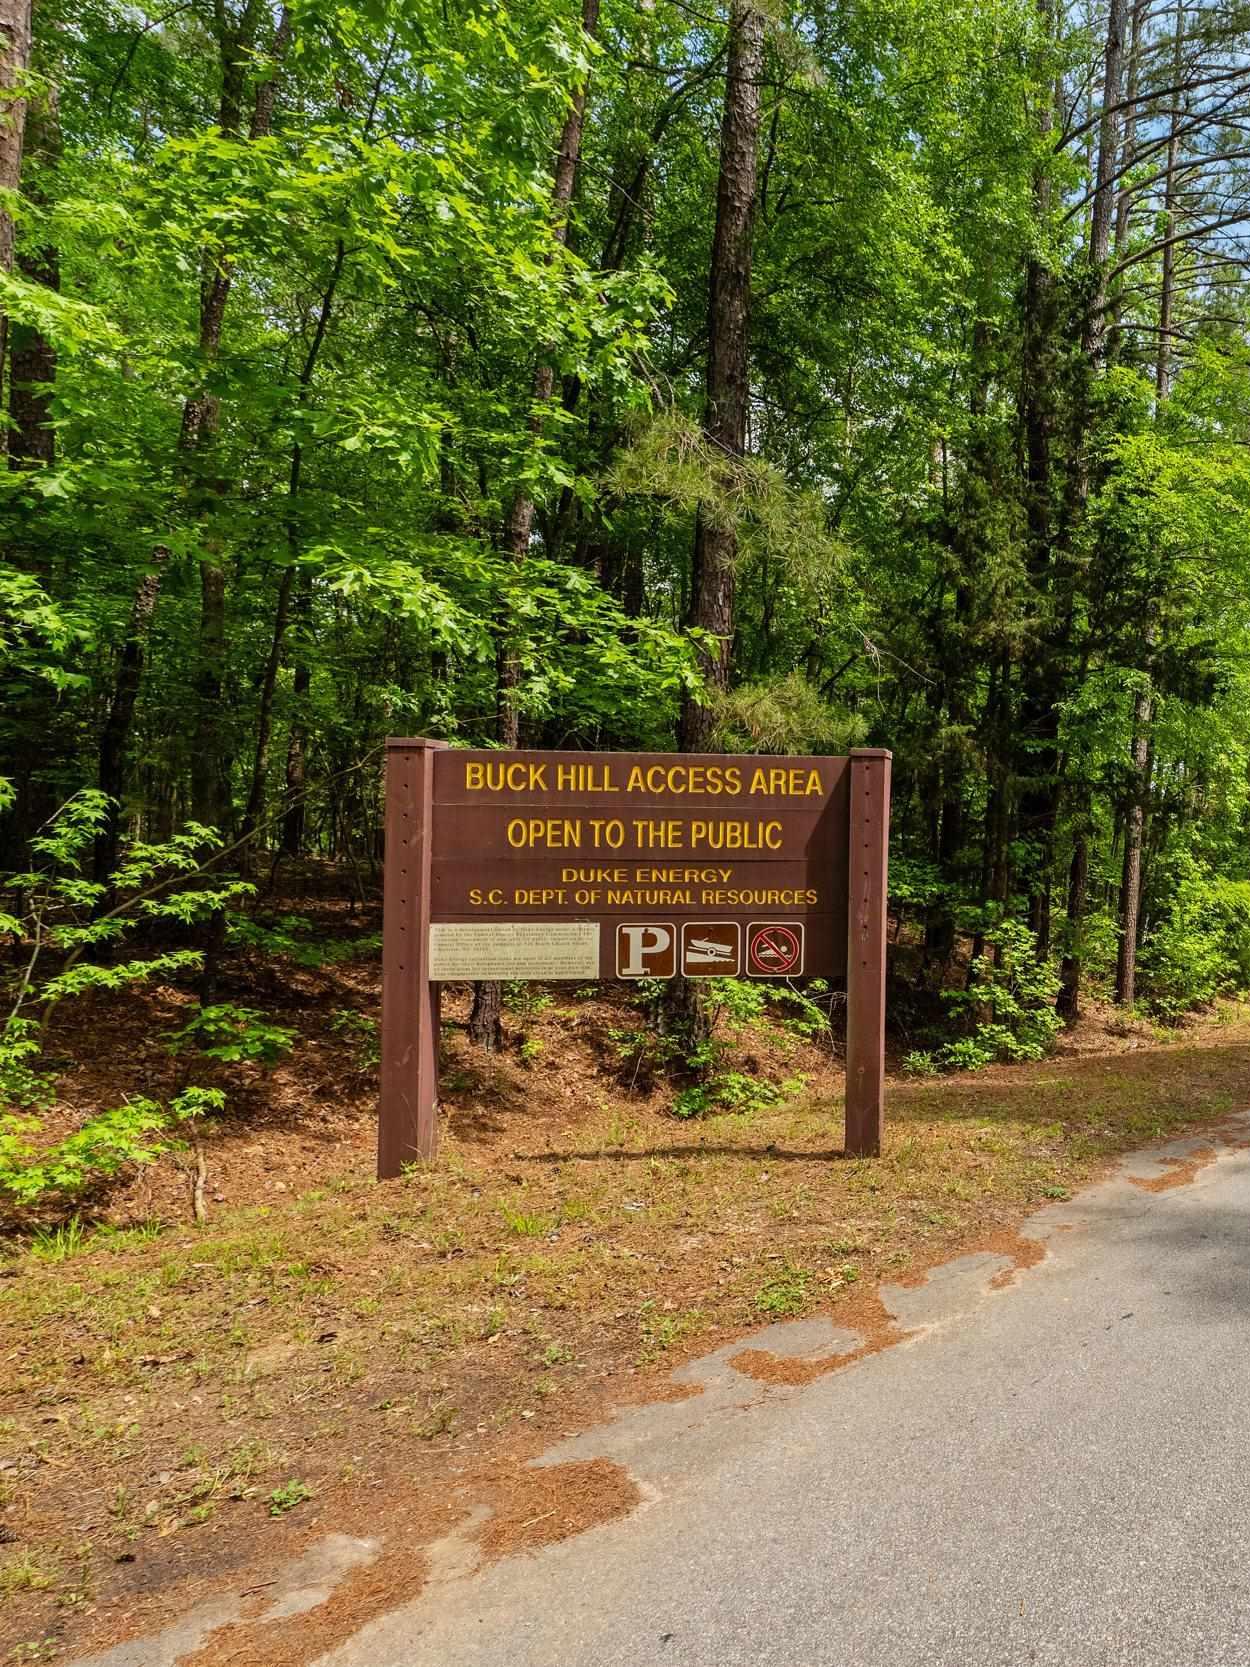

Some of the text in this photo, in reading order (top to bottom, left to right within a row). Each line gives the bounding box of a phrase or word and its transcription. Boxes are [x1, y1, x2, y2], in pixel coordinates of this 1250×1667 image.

[465, 762, 824, 796] BUCK HILL ACCESS AREA
[507, 818, 783, 849] OPEN TO THE PUBLIC
[562, 868, 733, 884] DUKE ENERGY
[469, 888, 818, 905] S.C. DEPT. OF NATURAL RESOURCES
[621, 926, 671, 975] P
